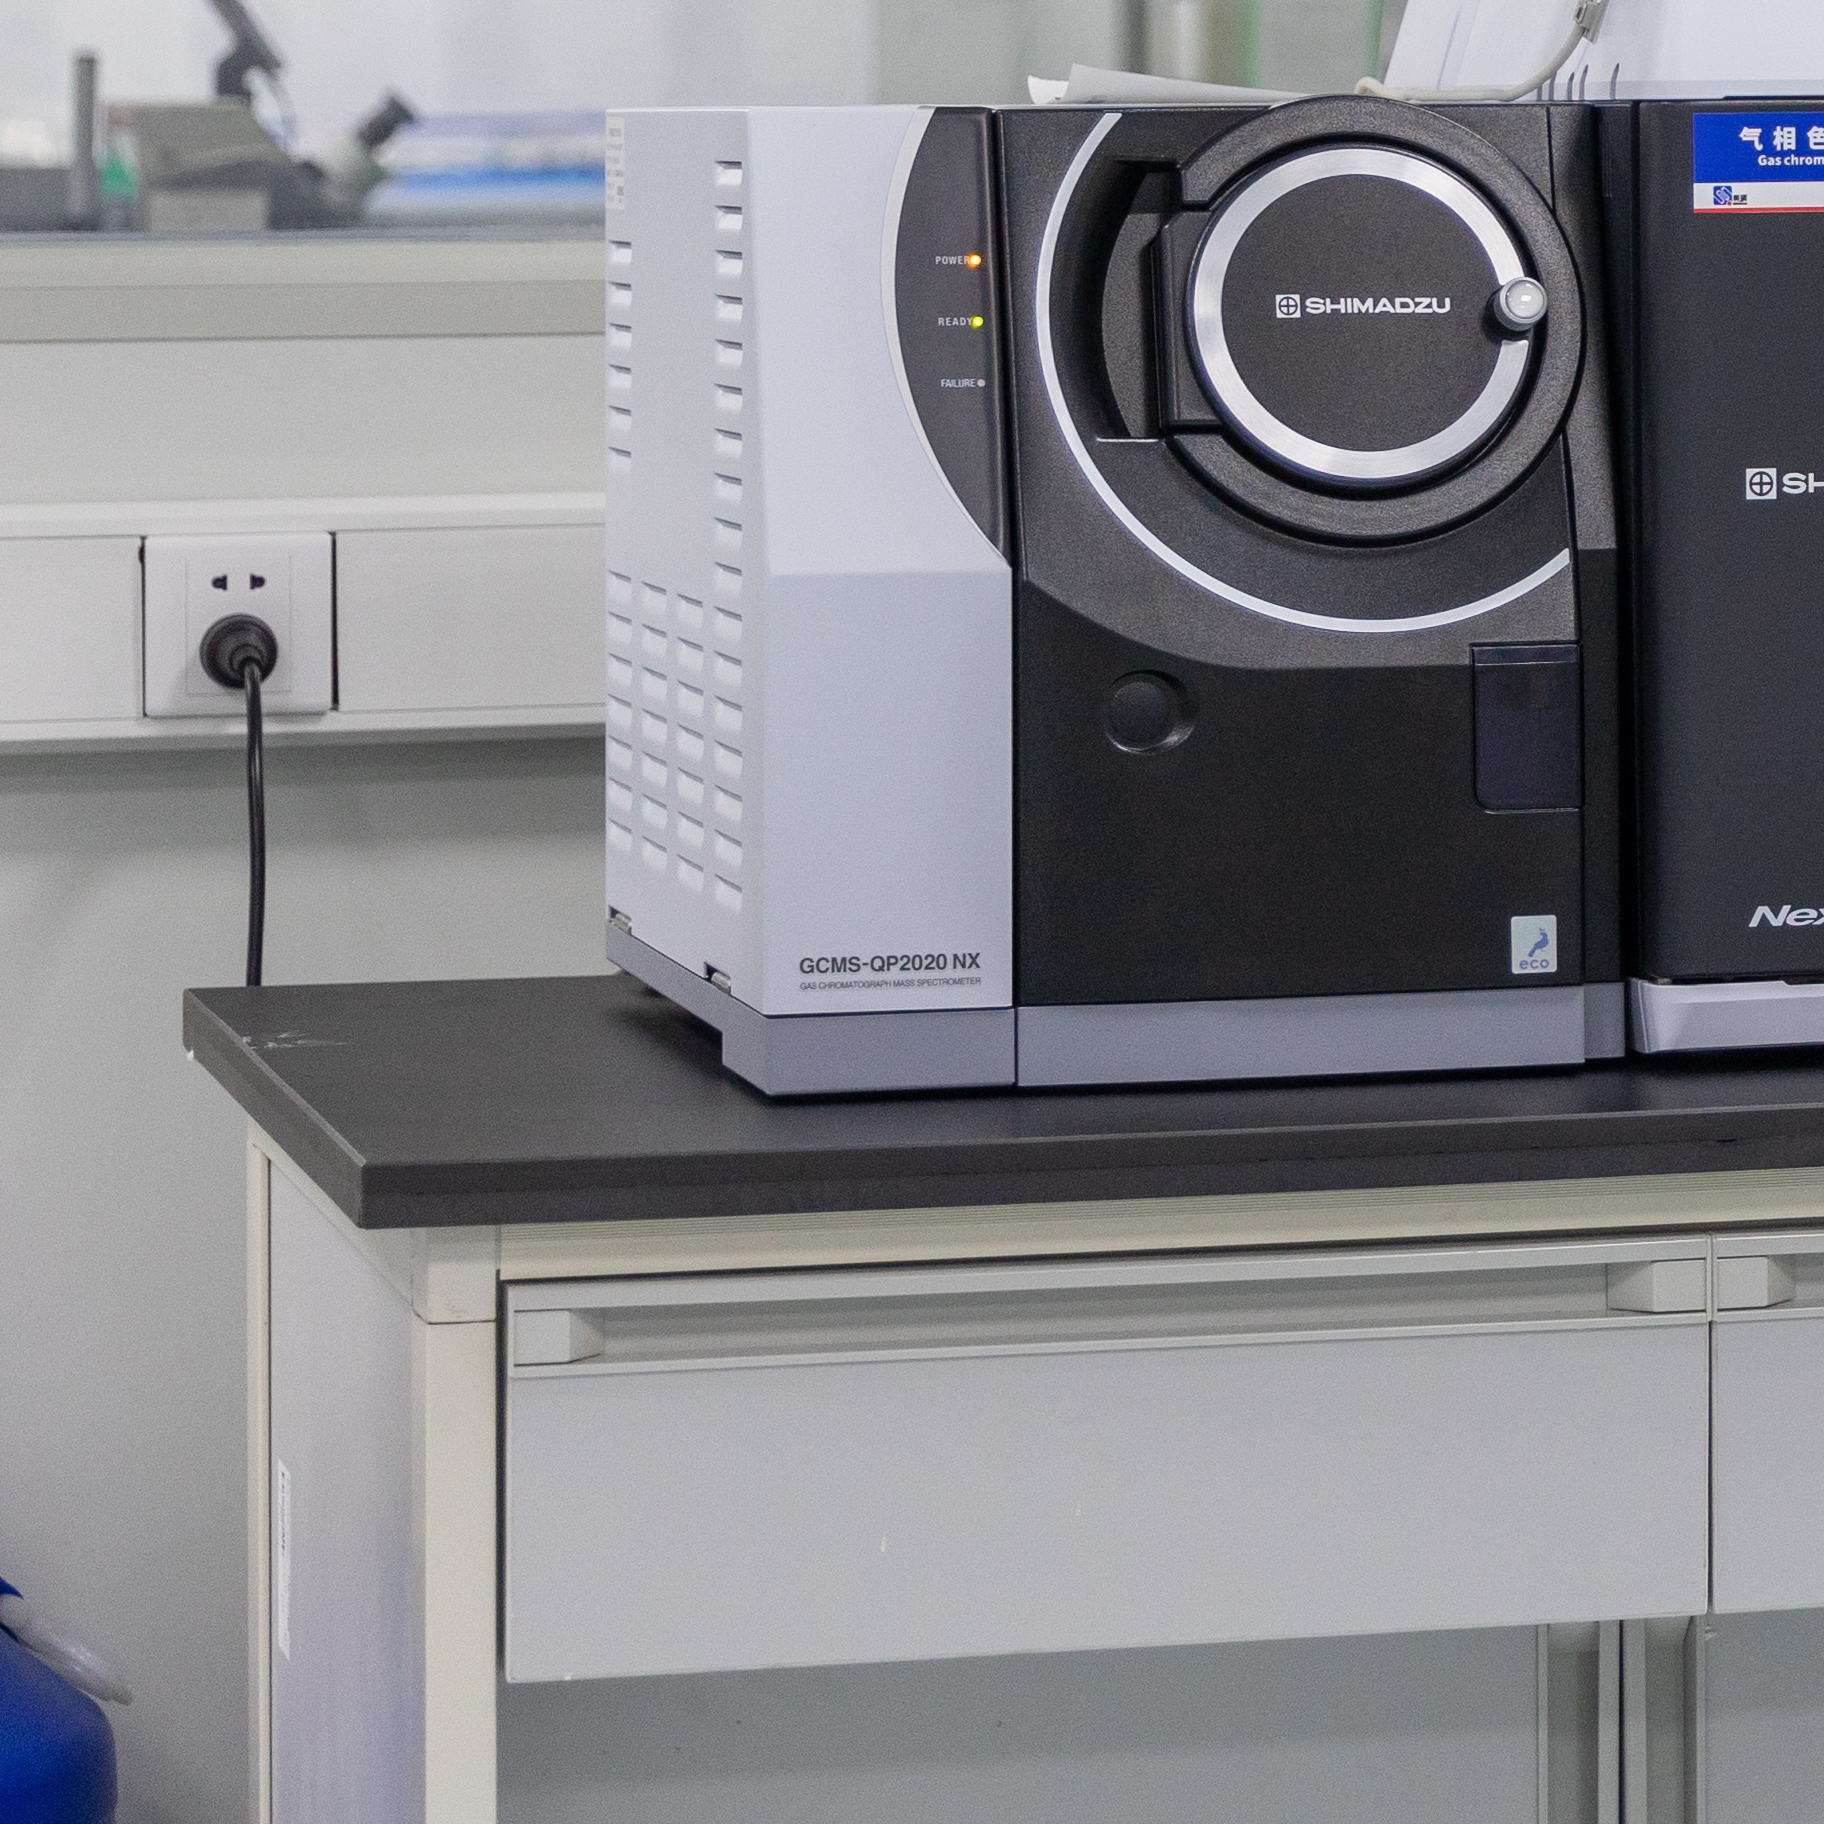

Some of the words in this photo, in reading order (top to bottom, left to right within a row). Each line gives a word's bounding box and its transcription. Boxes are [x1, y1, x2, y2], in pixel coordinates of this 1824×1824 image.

[1758, 154, 1782, 166] Gas
[935, 255, 970, 265] POWER
[1304, 295, 1451, 315] SHIMADZU
[938, 317, 973, 326] READY
[941, 379, 976, 388] FAILURE
[799, 953, 948, 974] GCMS-QP2020
[952, 952, 981, 970] NX
[1519, 958, 1550, 970] eco
[800, 982, 817, 991] GAS
[818, 980, 892, 990] CHROMATOGRAPH
[892, 979, 916, 988] MASS
[917, 977, 981, 987] SPECTROMETER
